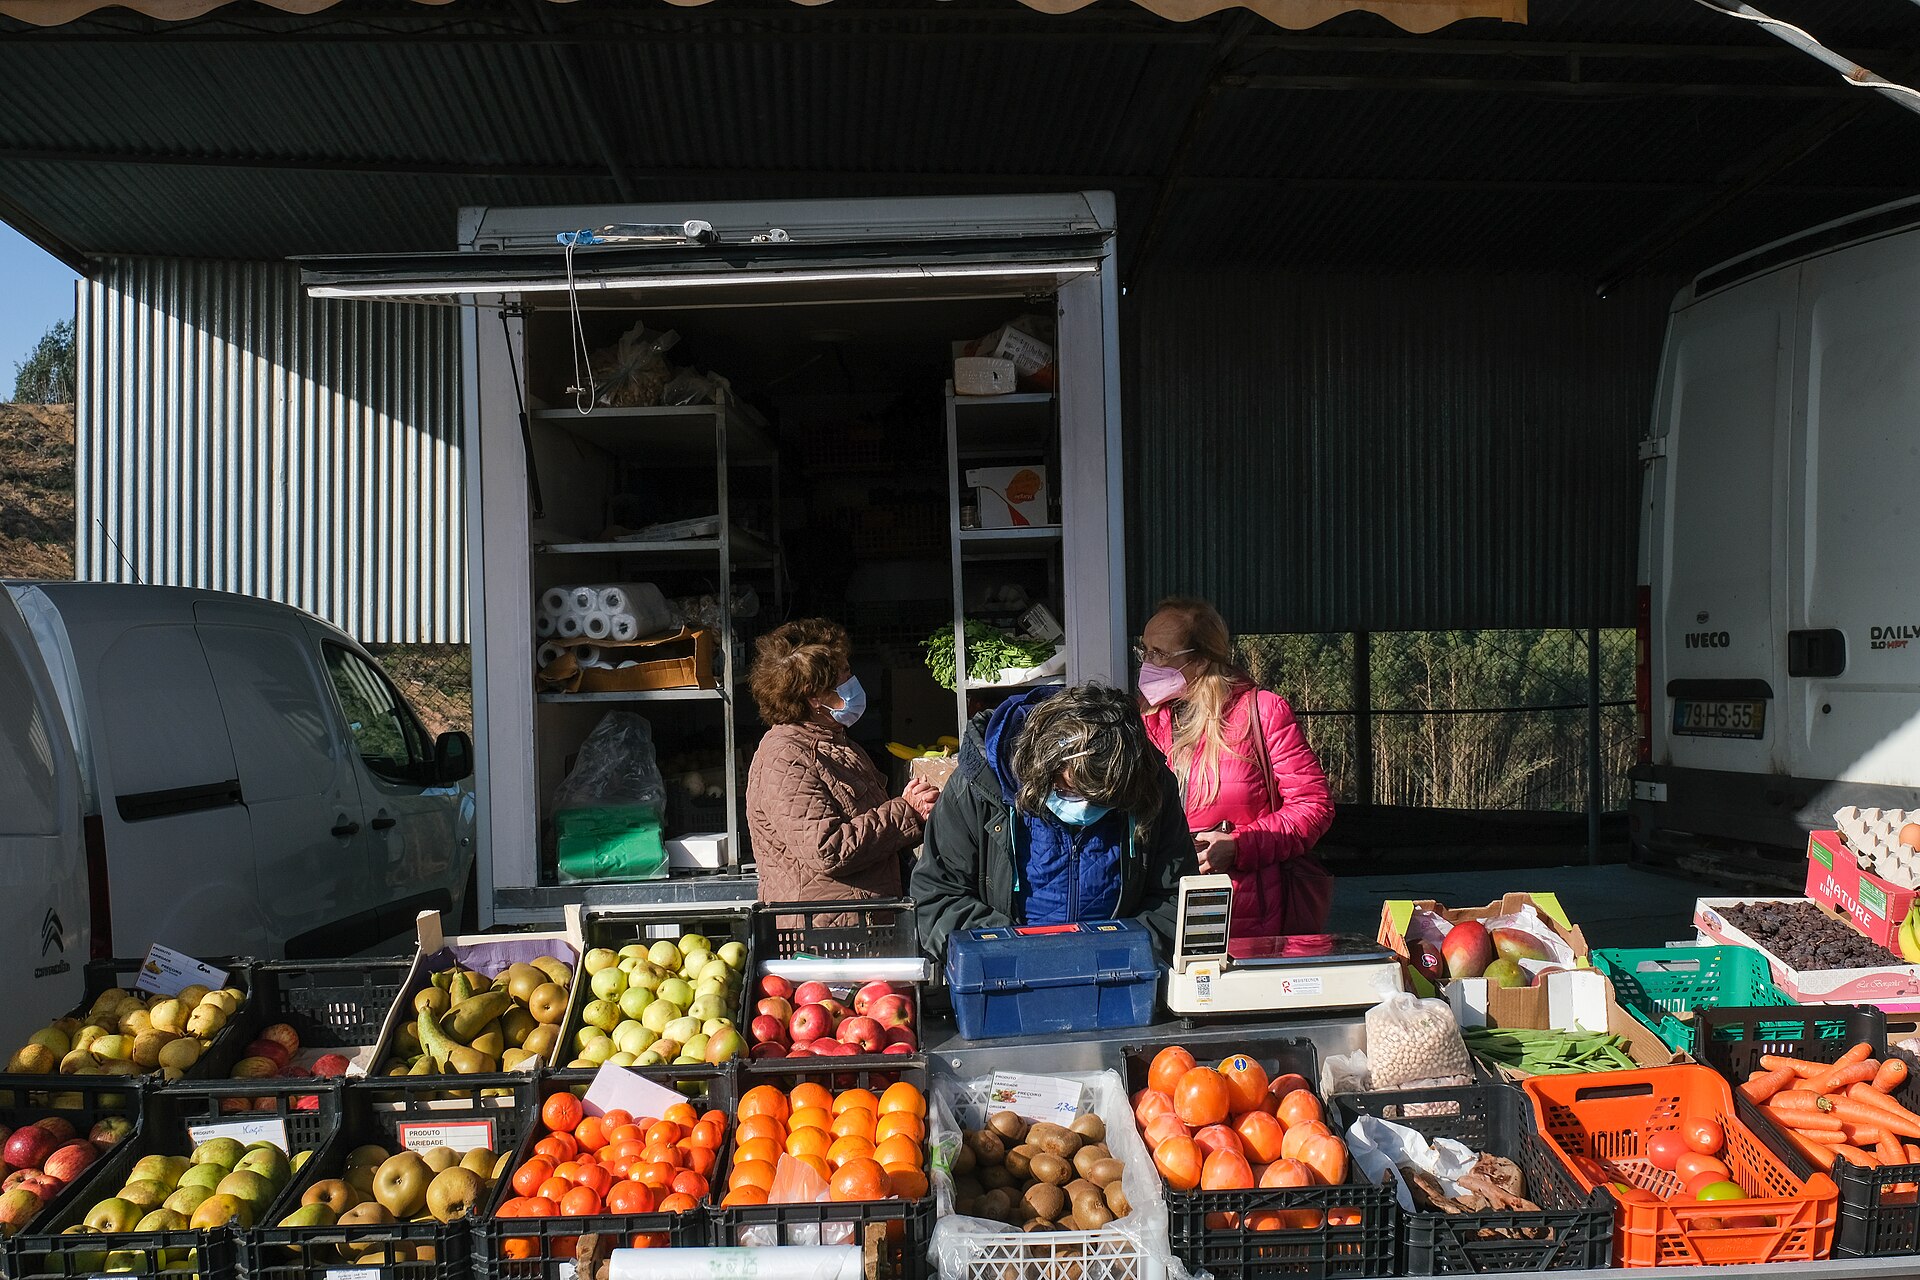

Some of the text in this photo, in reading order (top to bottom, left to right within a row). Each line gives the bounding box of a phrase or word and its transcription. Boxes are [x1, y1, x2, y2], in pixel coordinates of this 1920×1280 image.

[1685, 631, 1731, 649] IVECO
[1870, 625, 1920, 640] DAILY
[1826, 874, 1873, 928] NATURE
[409, 1129, 441, 1137] PRODUTO
[407, 1139, 444, 1147] VARIEDADE
